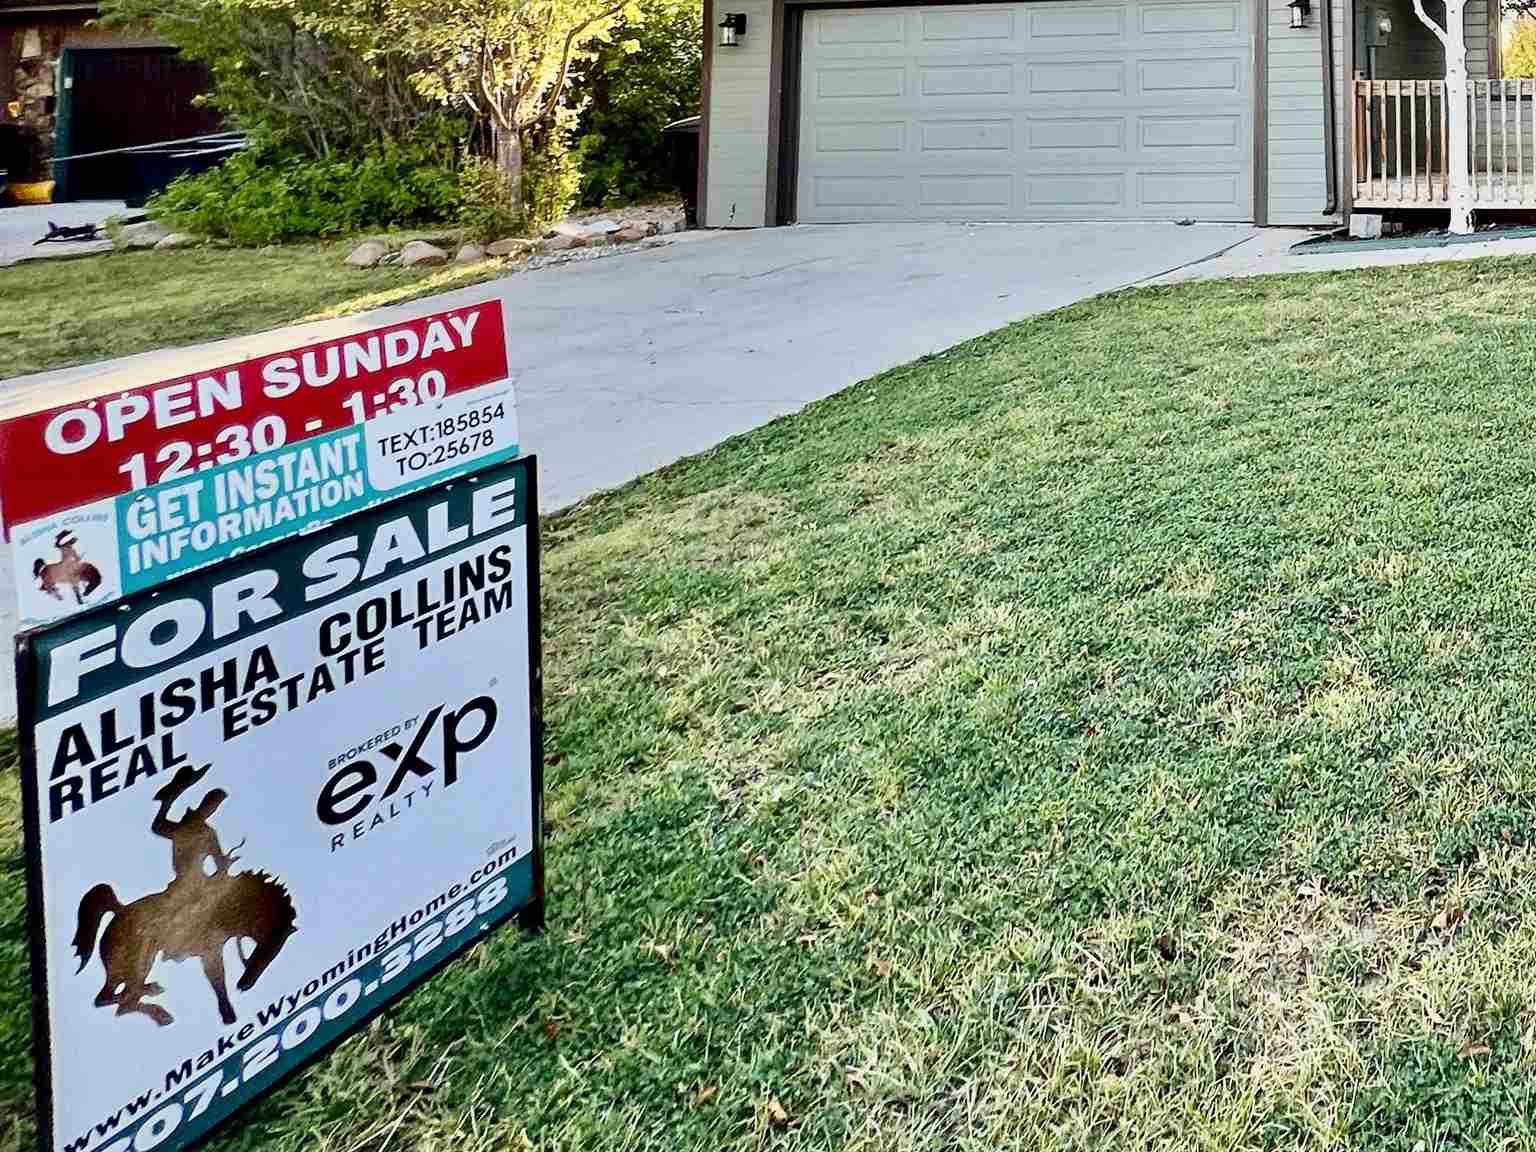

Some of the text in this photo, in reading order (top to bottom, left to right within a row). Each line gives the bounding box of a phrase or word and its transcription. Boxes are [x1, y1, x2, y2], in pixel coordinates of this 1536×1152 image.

[44, 311, 480, 456] OPEN SUNDAY
[119, 415, 287, 489] 12:30
[343, 369, 446, 425] 1:30
[378, 402, 505, 456] TEXT:185854
[126, 482, 203, 540] GET
[214, 433, 361, 508] INSTANT
[396, 429, 494, 476] TO:25678
[128, 471, 364, 575] INFORMATION
[47, 477, 516, 708] FOR SALE
[49, 544, 513, 781] ALISHA COLLINS
[49, 582, 513, 823] REAL ESTATE TEAM
[328, 715, 420, 770] BROKERED BY
[330, 780, 434, 853] REALTY
